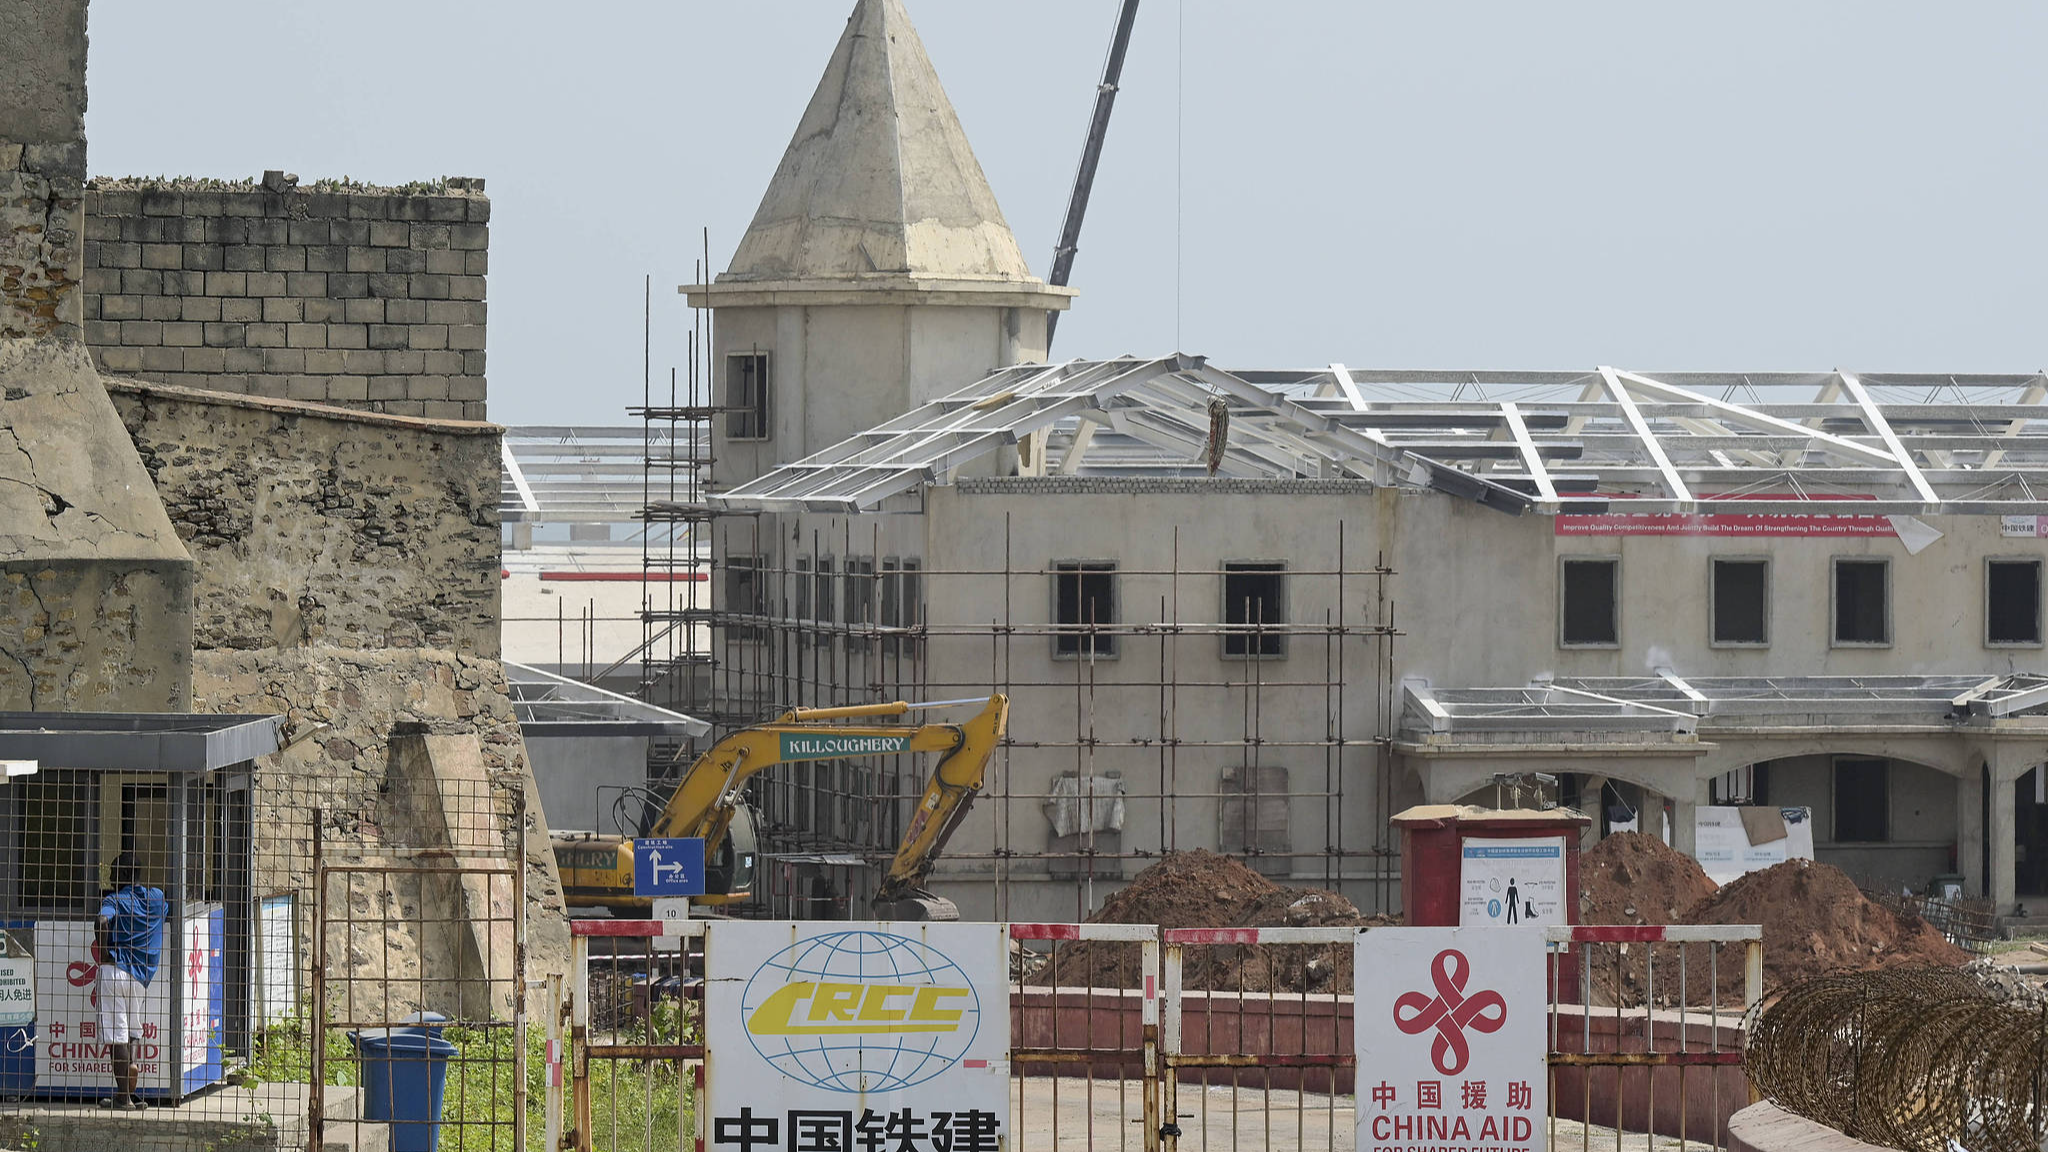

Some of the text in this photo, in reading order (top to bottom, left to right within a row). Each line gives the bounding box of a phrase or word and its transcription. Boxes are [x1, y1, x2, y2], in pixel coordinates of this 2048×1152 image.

[1563, 524, 1589, 532] Improve
[1590, 524, 1612, 532] Quality
[1613, 524, 1665, 532] Competitiveness
[1680, 524, 1701, 532] Jointly
[790, 737, 904, 753] KILLOUGHERY
[666, 909, 677, 918] 10
[747, 982, 970, 1034] CRCC
[49, 1021, 158, 1039] 中国助
[136, 1043, 159, 1060] ID
[49, 1062, 70, 1073] FOR
[72, 1062, 113, 1074] SHARED
[1372, 1080, 1532, 1110] 中国援助
[714, 1107, 1001, 1152] 中国铁建
[1372, 1115, 1532, 1142] CHINA AID
